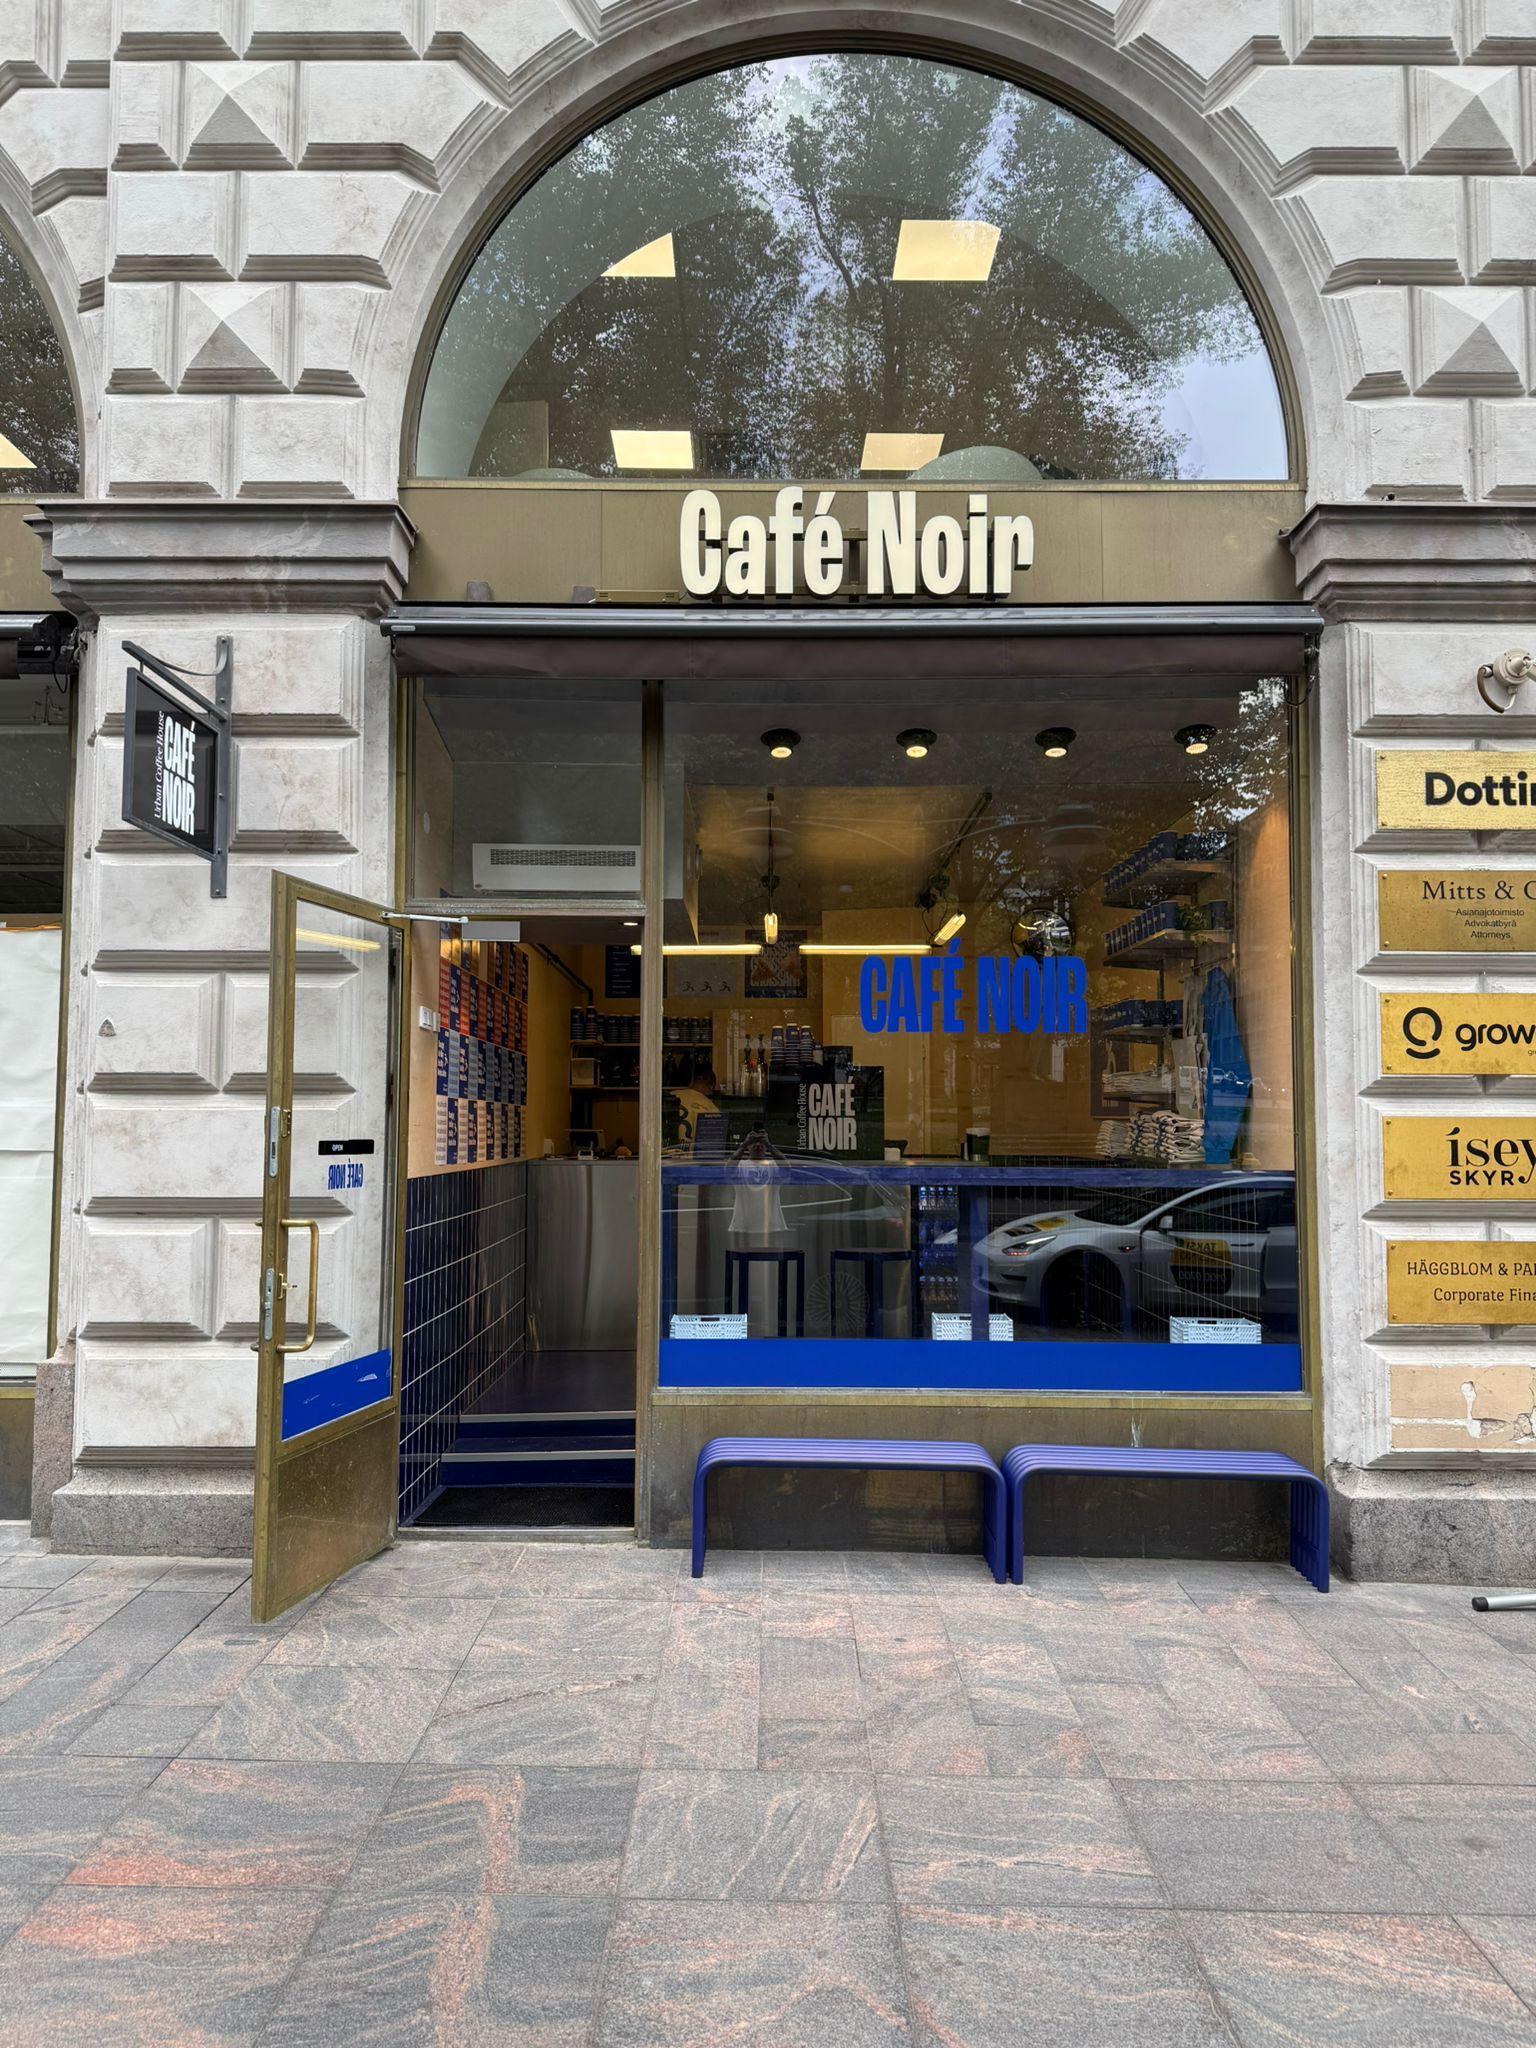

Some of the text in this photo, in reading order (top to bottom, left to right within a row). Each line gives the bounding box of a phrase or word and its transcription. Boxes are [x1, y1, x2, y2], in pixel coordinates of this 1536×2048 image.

[680, 486, 1035, 596] Café Noir
[164, 715, 196, 785] CAFÉ
[154, 710, 165, 819] Urban Coffee House
[161, 768, 196, 836] NOIR
[1422, 880, 1486, 900] Mitts
[1494, 880, 1515, 900] &
[1455, 908, 1525, 919] Asianajotoimisto
[1464, 920, 1517, 929] Advokatbyrå
[1470, 930, 1511, 940] Attorneys
[859, 937, 1088, 1034] CAFÉ NOIR
[1455, 1023, 1536, 1051] grow
[808, 1075, 856, 1117] CAFÉ
[808, 1117, 857, 1151] NOIR
[1449, 1170, 1515, 1186] SKYR
[1407, 1259, 1493, 1276] HÄGGBLOM
[1498, 1263, 1508, 1276] &
[1433, 1288, 1504, 1304] Corporate
